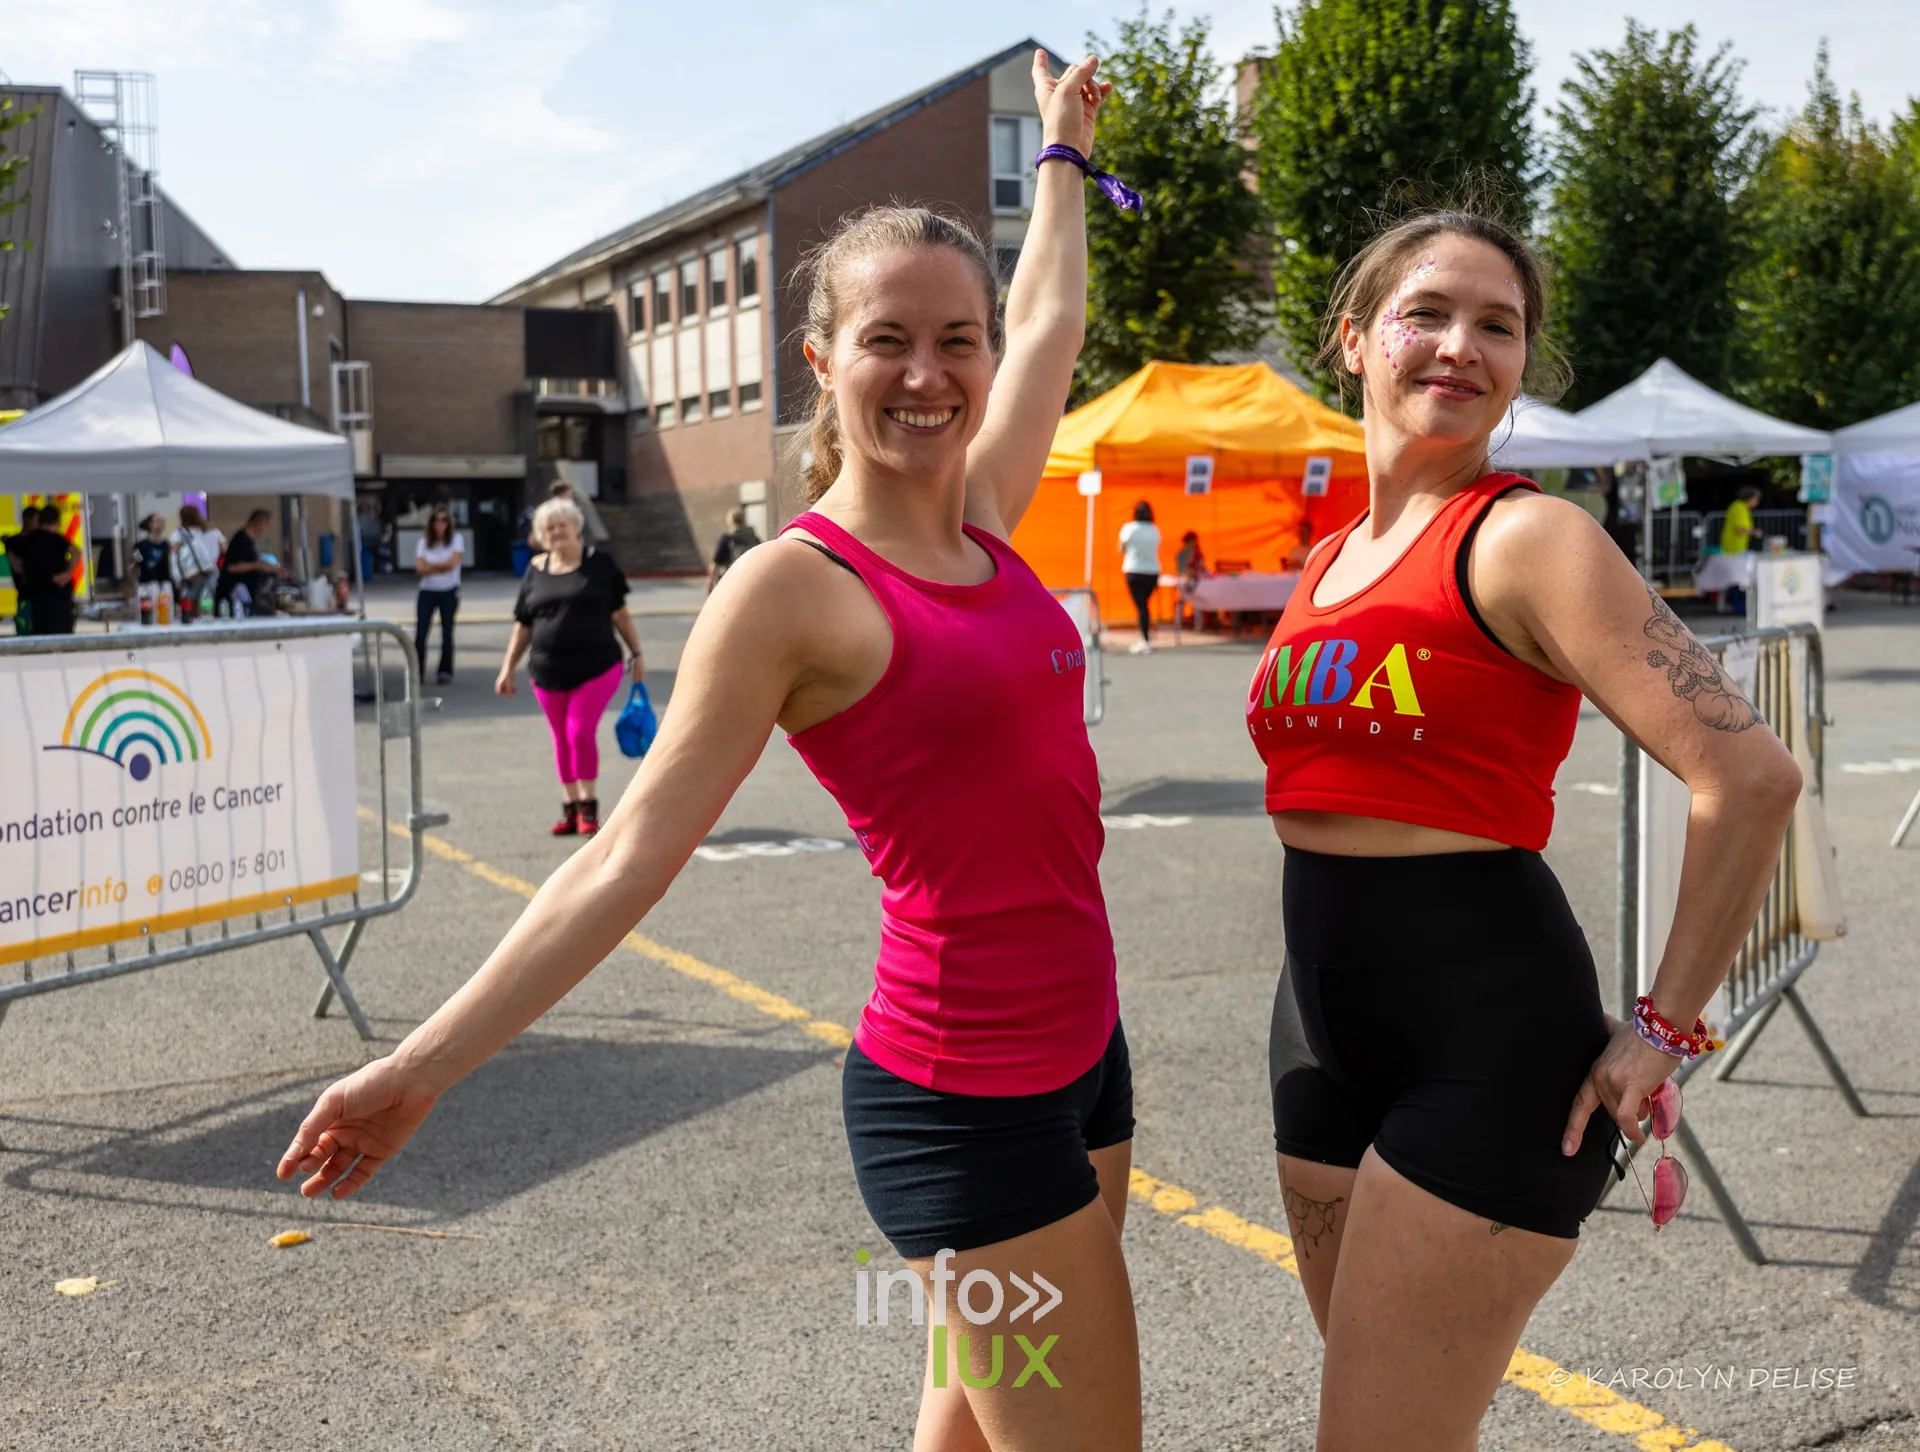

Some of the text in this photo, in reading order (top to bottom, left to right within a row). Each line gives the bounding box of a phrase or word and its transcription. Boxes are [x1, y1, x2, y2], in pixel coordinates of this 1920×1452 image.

[112, 797, 181, 828] contre
[189, 791, 206, 816] le
[213, 782, 284, 812] Cancer
[169, 861, 224, 893] 0800
[230, 856, 248, 880] 15
[254, 849, 286, 875] 801
